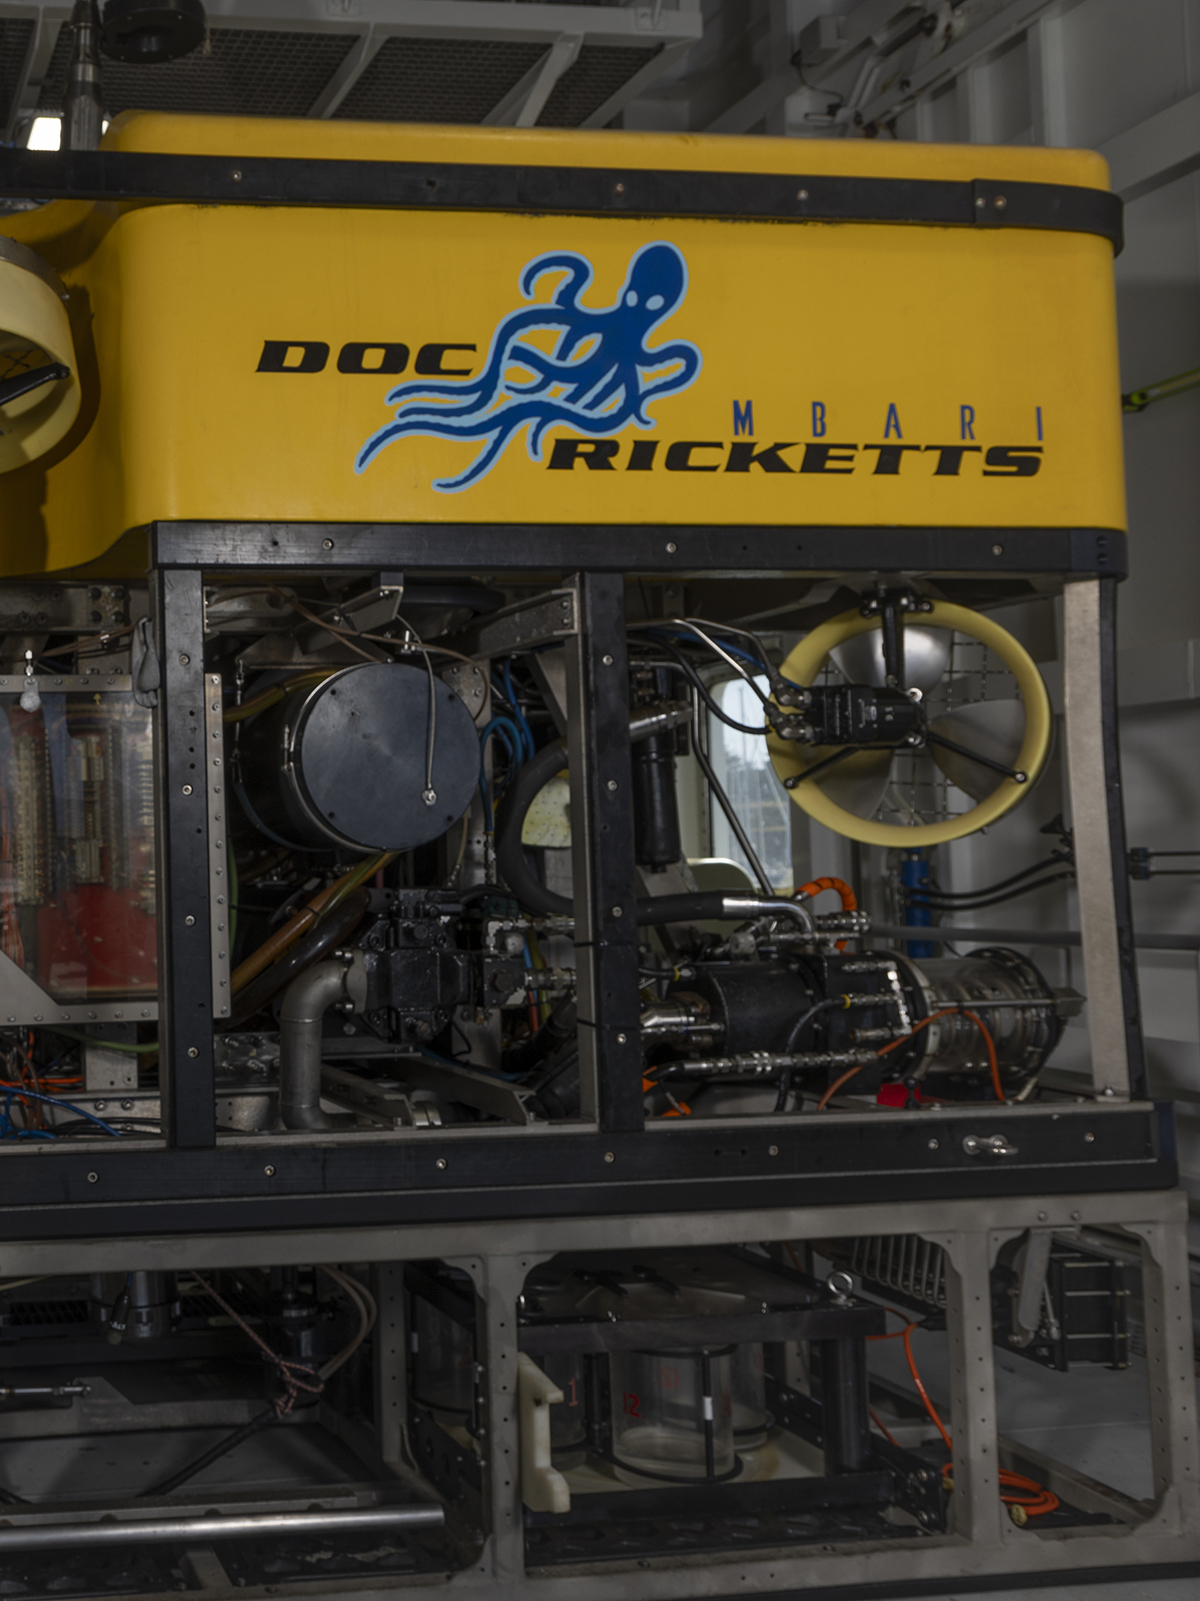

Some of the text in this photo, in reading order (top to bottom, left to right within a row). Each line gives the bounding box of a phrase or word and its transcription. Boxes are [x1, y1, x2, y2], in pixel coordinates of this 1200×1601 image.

[255, 340, 477, 376] DOC
[732, 399, 1044, 442] MBARI
[546, 438, 1045, 477] RICKETTS
[568, 1376, 579, 1407] 1
[623, 1392, 641, 1418] 12
